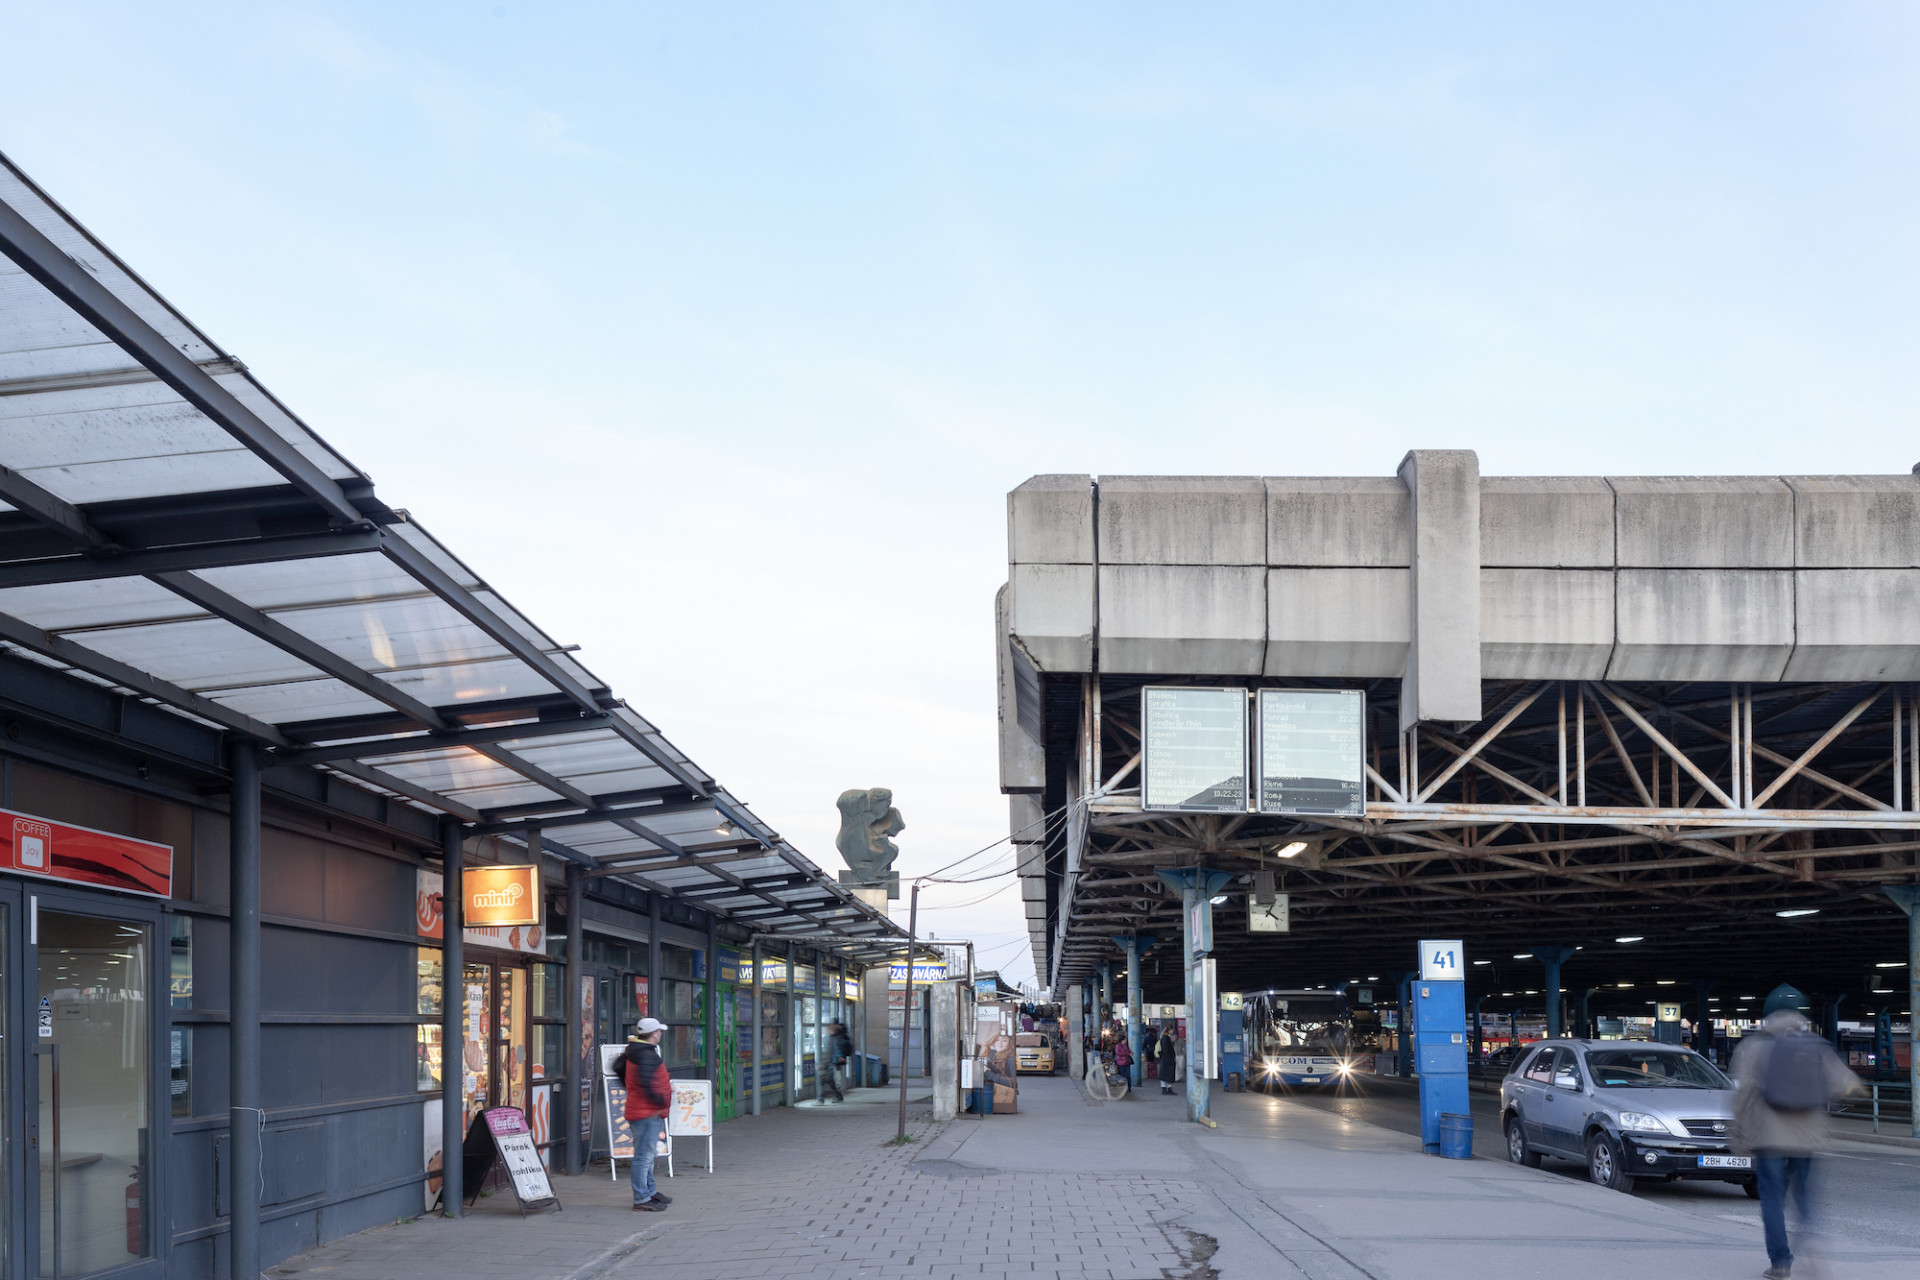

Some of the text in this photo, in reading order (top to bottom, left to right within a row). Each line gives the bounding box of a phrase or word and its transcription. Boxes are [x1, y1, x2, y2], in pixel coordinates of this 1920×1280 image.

[15, 821, 49, 838] COFFEE
[25, 843, 40, 859] Joy
[1432, 950, 1456, 969] 41
[891, 966, 947, 980] ZASAVÁRNA
[1226, 997, 1239, 1006] 42
[1664, 1007, 1677, 1016] 37
[504, 1143, 530, 1152] Párek
[1705, 1157, 1747, 1166] 2BH 4620
